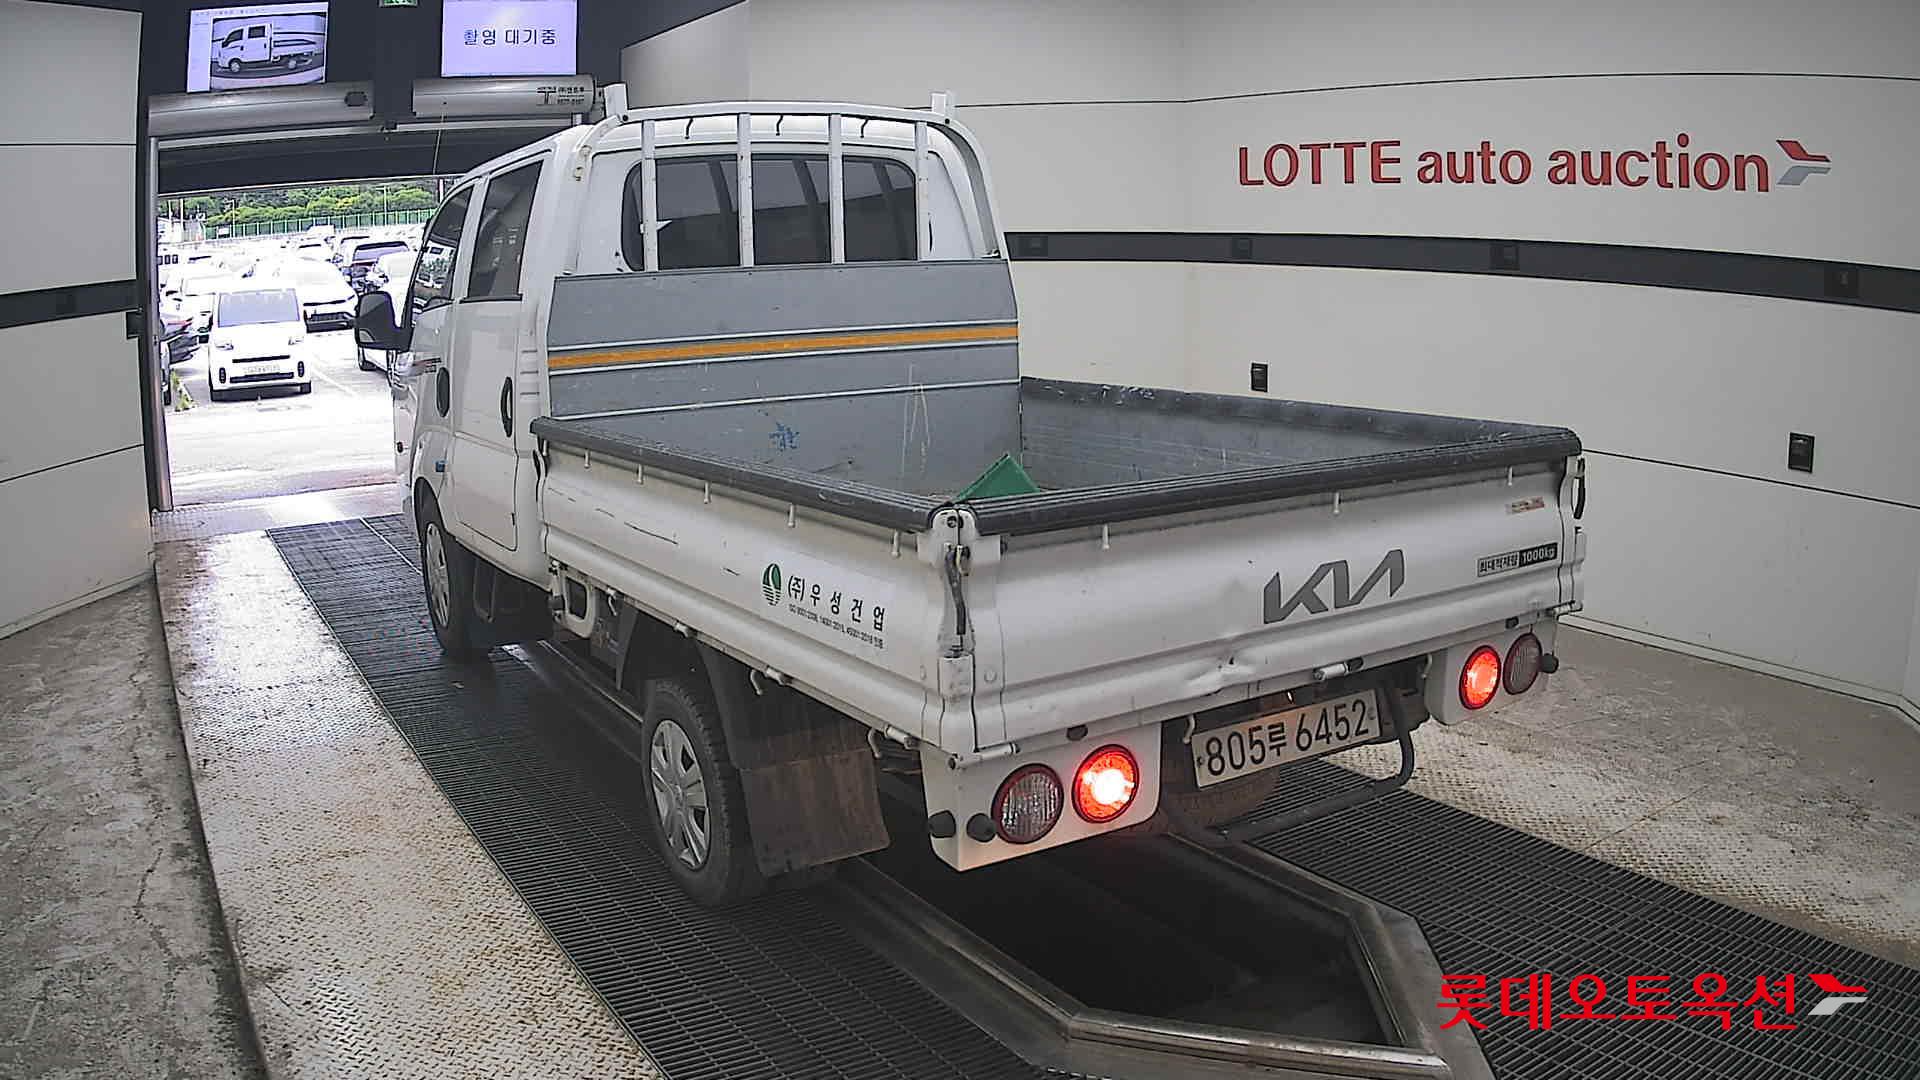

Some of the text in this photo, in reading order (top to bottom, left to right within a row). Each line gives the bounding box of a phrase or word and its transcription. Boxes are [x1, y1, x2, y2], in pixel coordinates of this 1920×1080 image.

[464, 28, 556, 46] 촬영 대기중
[1238, 132, 1770, 193] LOTTE auto auction
[1263, 549, 1405, 625] KIA
[1205, 699, 1370, 776] 805루 6452
